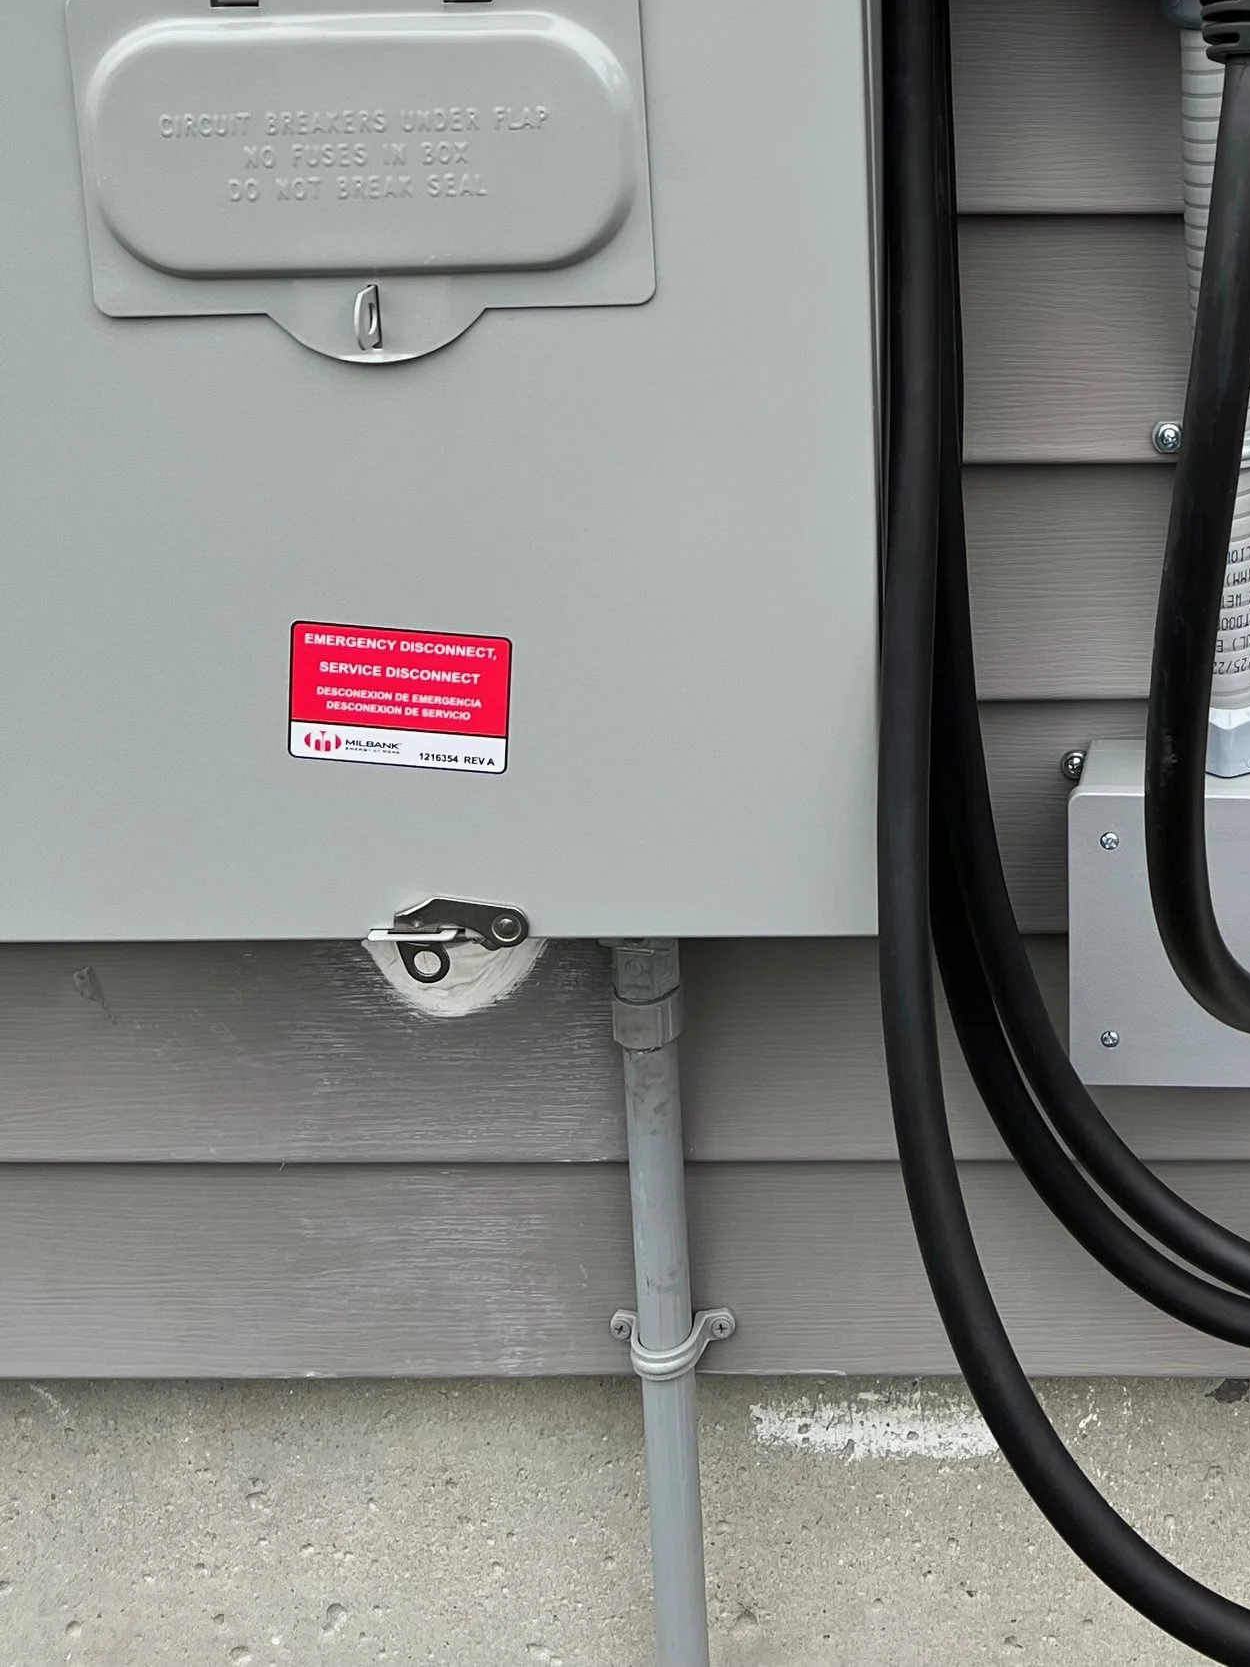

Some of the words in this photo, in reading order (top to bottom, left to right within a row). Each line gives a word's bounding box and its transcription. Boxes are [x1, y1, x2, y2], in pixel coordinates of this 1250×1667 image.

[158, 111, 250, 139] CIRCUIT
[265, 109, 388, 136] BREAKERS
[401, 107, 480, 133] UNDER
[493, 106, 549, 131] FLAP
[243, 145, 276, 169] NO
[291, 143, 368, 168] FUSES
[382, 142, 407, 166] IN
[421, 141, 470, 165] BOX
[228, 178, 260, 202] DO
[275, 177, 323, 201] NOT
[336, 175, 414, 200] BREAK
[426, 173, 488, 198] SEAL
[304, 633, 397, 651] EMERGENCY
[400, 640, 498, 660] DISCONNECT,
[319, 661, 382, 677] SERVICE
[386, 667, 481, 685] DISCONNECT
[316, 686, 392, 701] DESCONEXION
[394, 692, 409, 703] DE
[412, 694, 482, 708] EMERGENCIA
[326, 700, 402, 715] DESCONEXION
[404, 707, 419, 716] DE
[421, 708, 471, 721] SERVICIO
[345, 739, 399, 749] MILBANK
[419, 752, 459, 764] 1216354
[463, 755, 485, 766] REV
[486, 757, 495, 767] A
